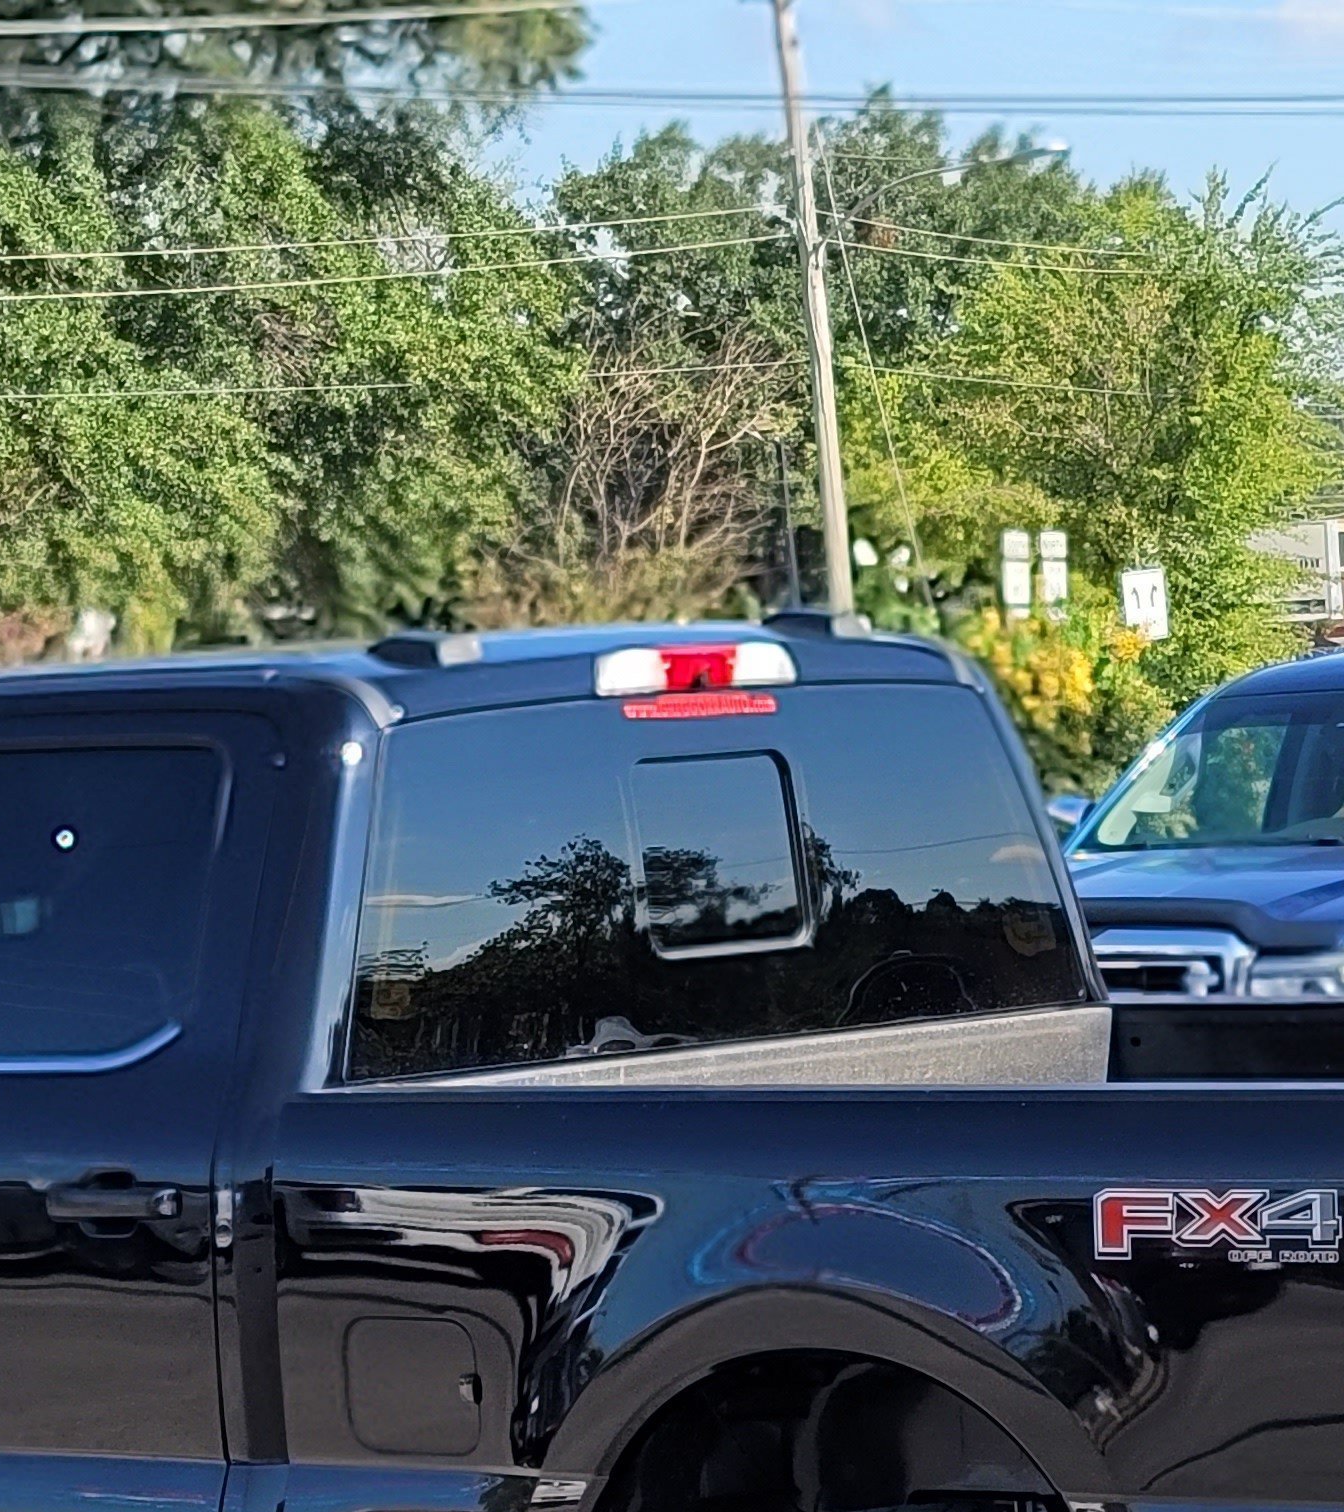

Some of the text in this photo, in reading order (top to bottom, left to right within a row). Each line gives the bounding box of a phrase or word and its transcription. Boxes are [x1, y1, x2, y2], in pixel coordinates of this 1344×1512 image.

[1093, 1188, 1343, 1261] FX4
[1228, 1250, 1339, 1263] OFF ROAD
